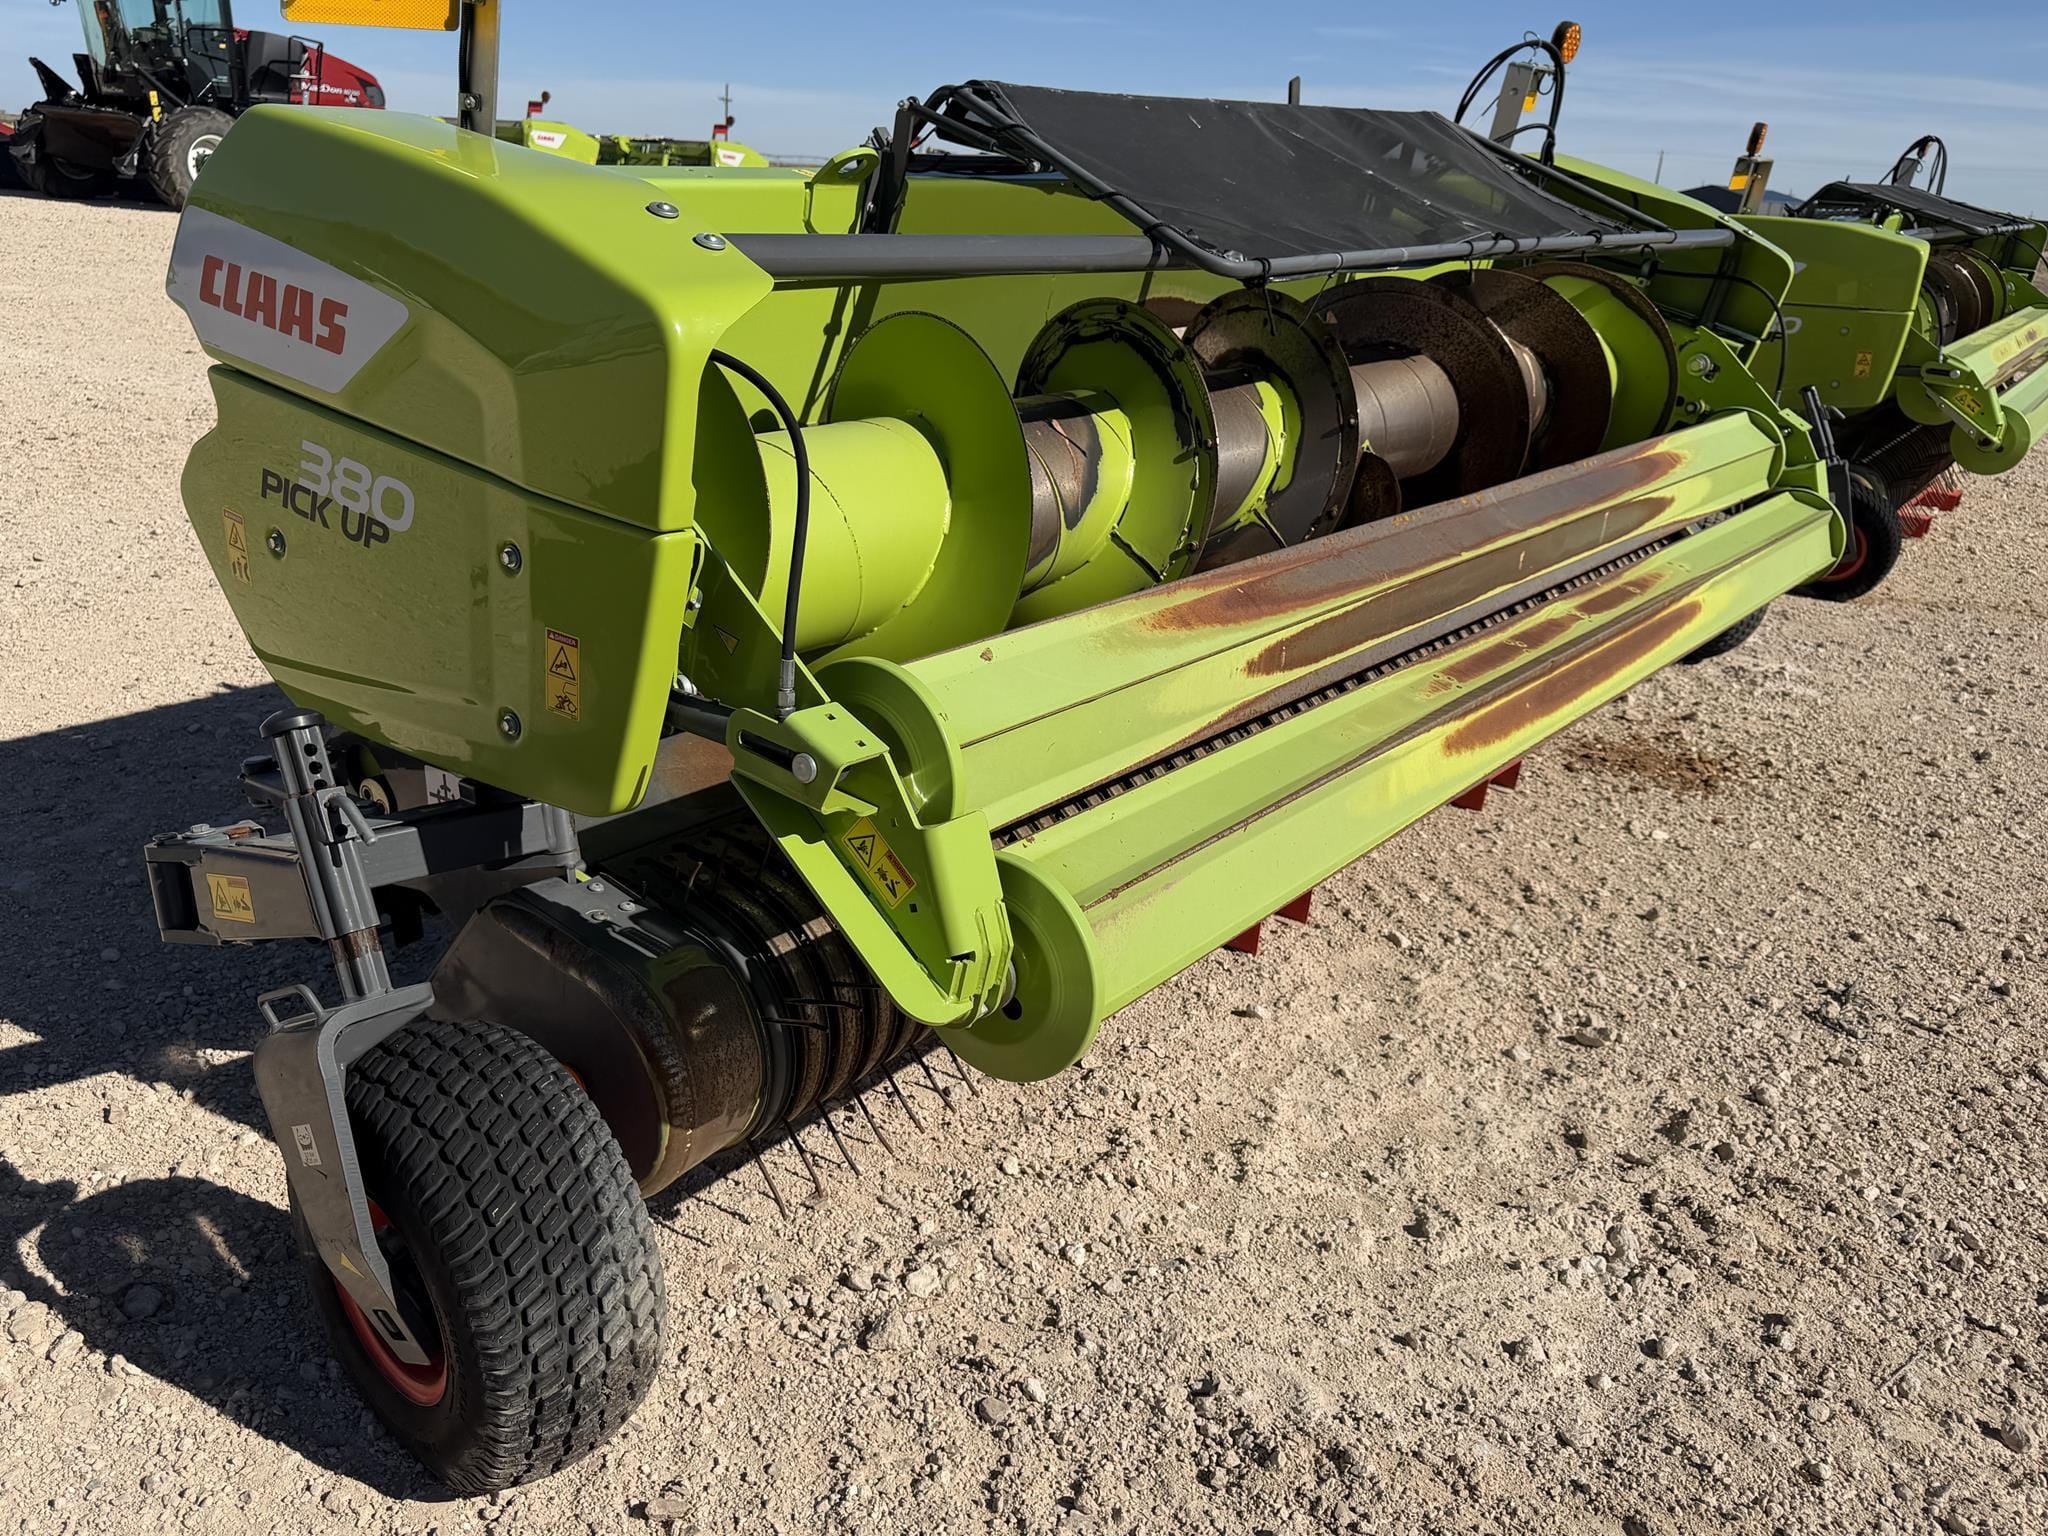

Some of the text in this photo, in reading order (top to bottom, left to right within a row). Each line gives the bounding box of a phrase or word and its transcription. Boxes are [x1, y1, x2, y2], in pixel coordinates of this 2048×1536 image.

[199, 254, 349, 355] CLAAS
[261, 467, 391, 549] PICK UP
[299, 439, 415, 533] 380
